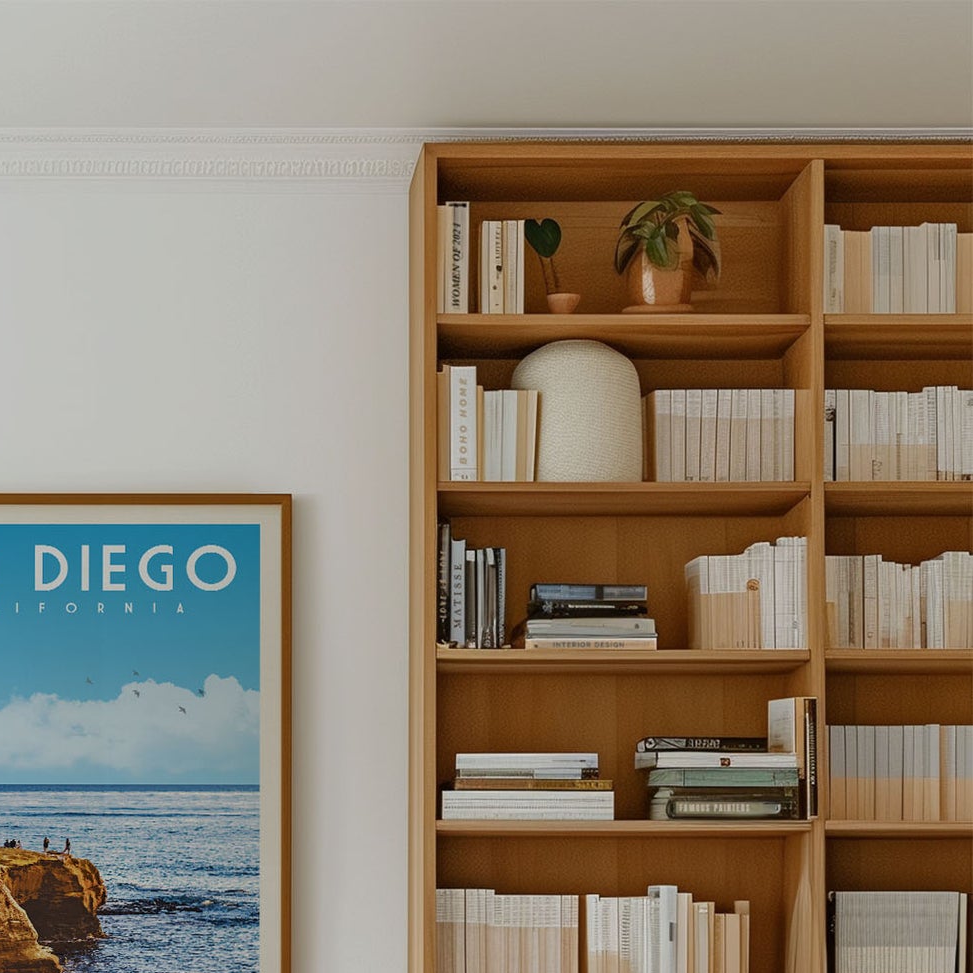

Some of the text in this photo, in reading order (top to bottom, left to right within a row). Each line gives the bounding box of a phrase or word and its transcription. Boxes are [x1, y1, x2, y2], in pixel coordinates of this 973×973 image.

[452, 248, 461, 262] OF
[451, 264, 461, 307] WOMEN
[459, 377, 468, 418] HOME
[459, 425, 468, 465] BOHO
[34, 544, 237, 592] DIEGO
[453, 563, 463, 629] MATISSE
[552, 641, 625, 649] INTERIOR DESIGN
[678, 803, 751, 813] FAMOUS PAINTERS
